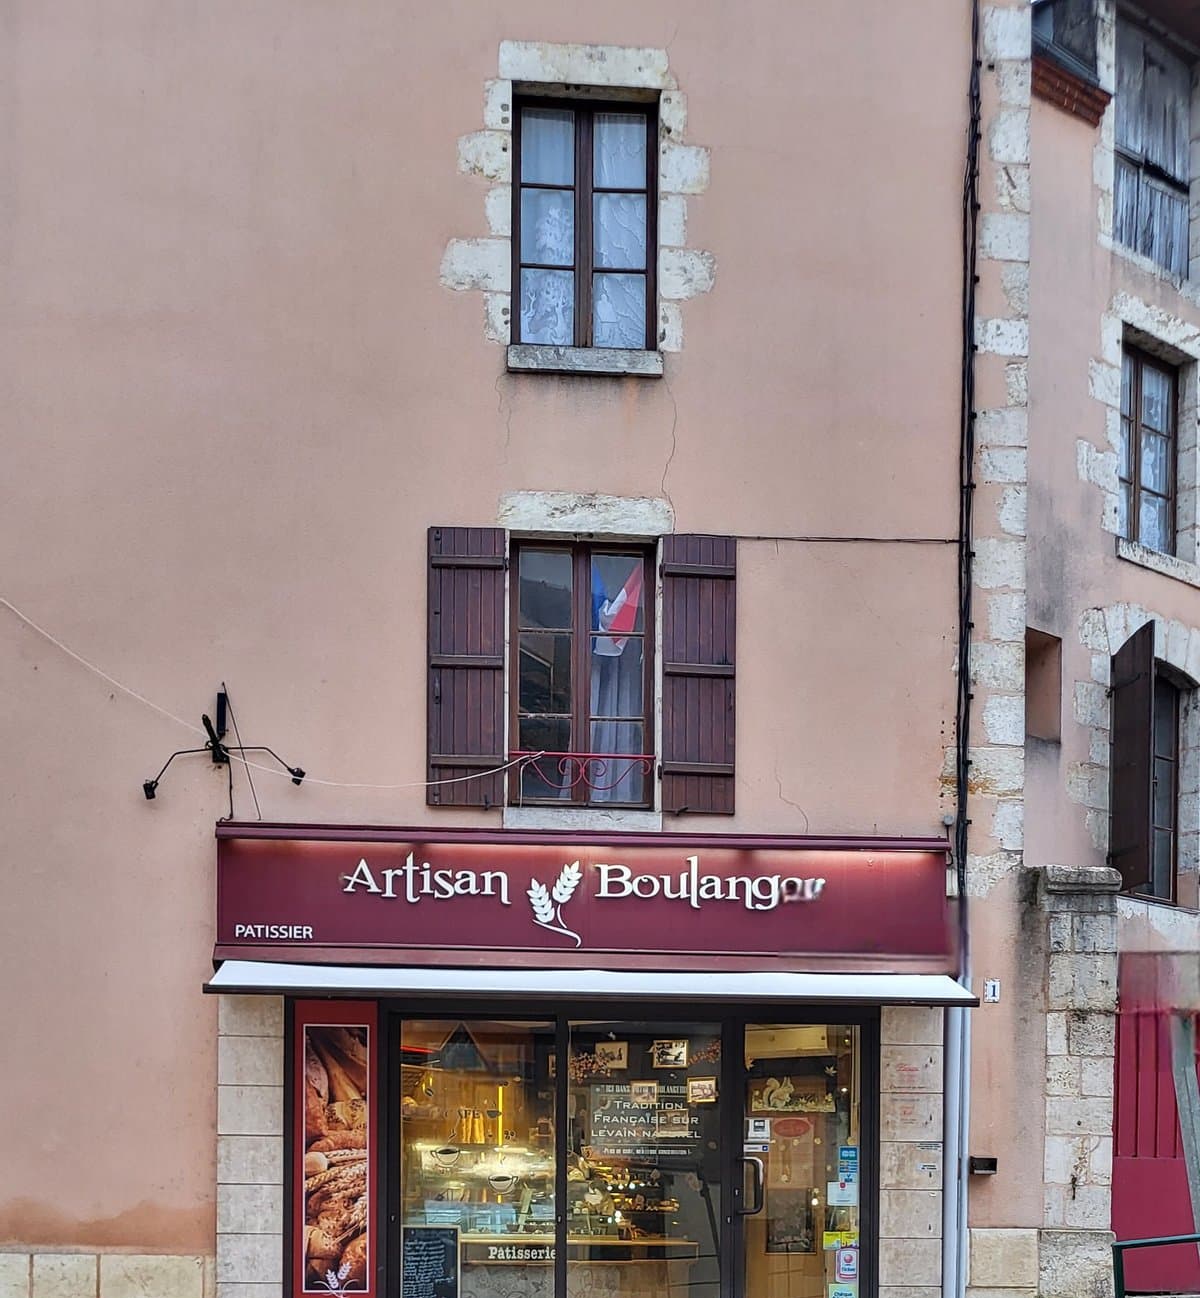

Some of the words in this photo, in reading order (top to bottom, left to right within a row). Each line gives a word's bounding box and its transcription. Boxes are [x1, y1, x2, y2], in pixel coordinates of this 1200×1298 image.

[343, 851, 512, 905] Artisan
[235, 924, 313, 939] PATISSIER
[991, 984, 997, 997] 1
[488, 1246, 556, 1259] Pâtisserie
